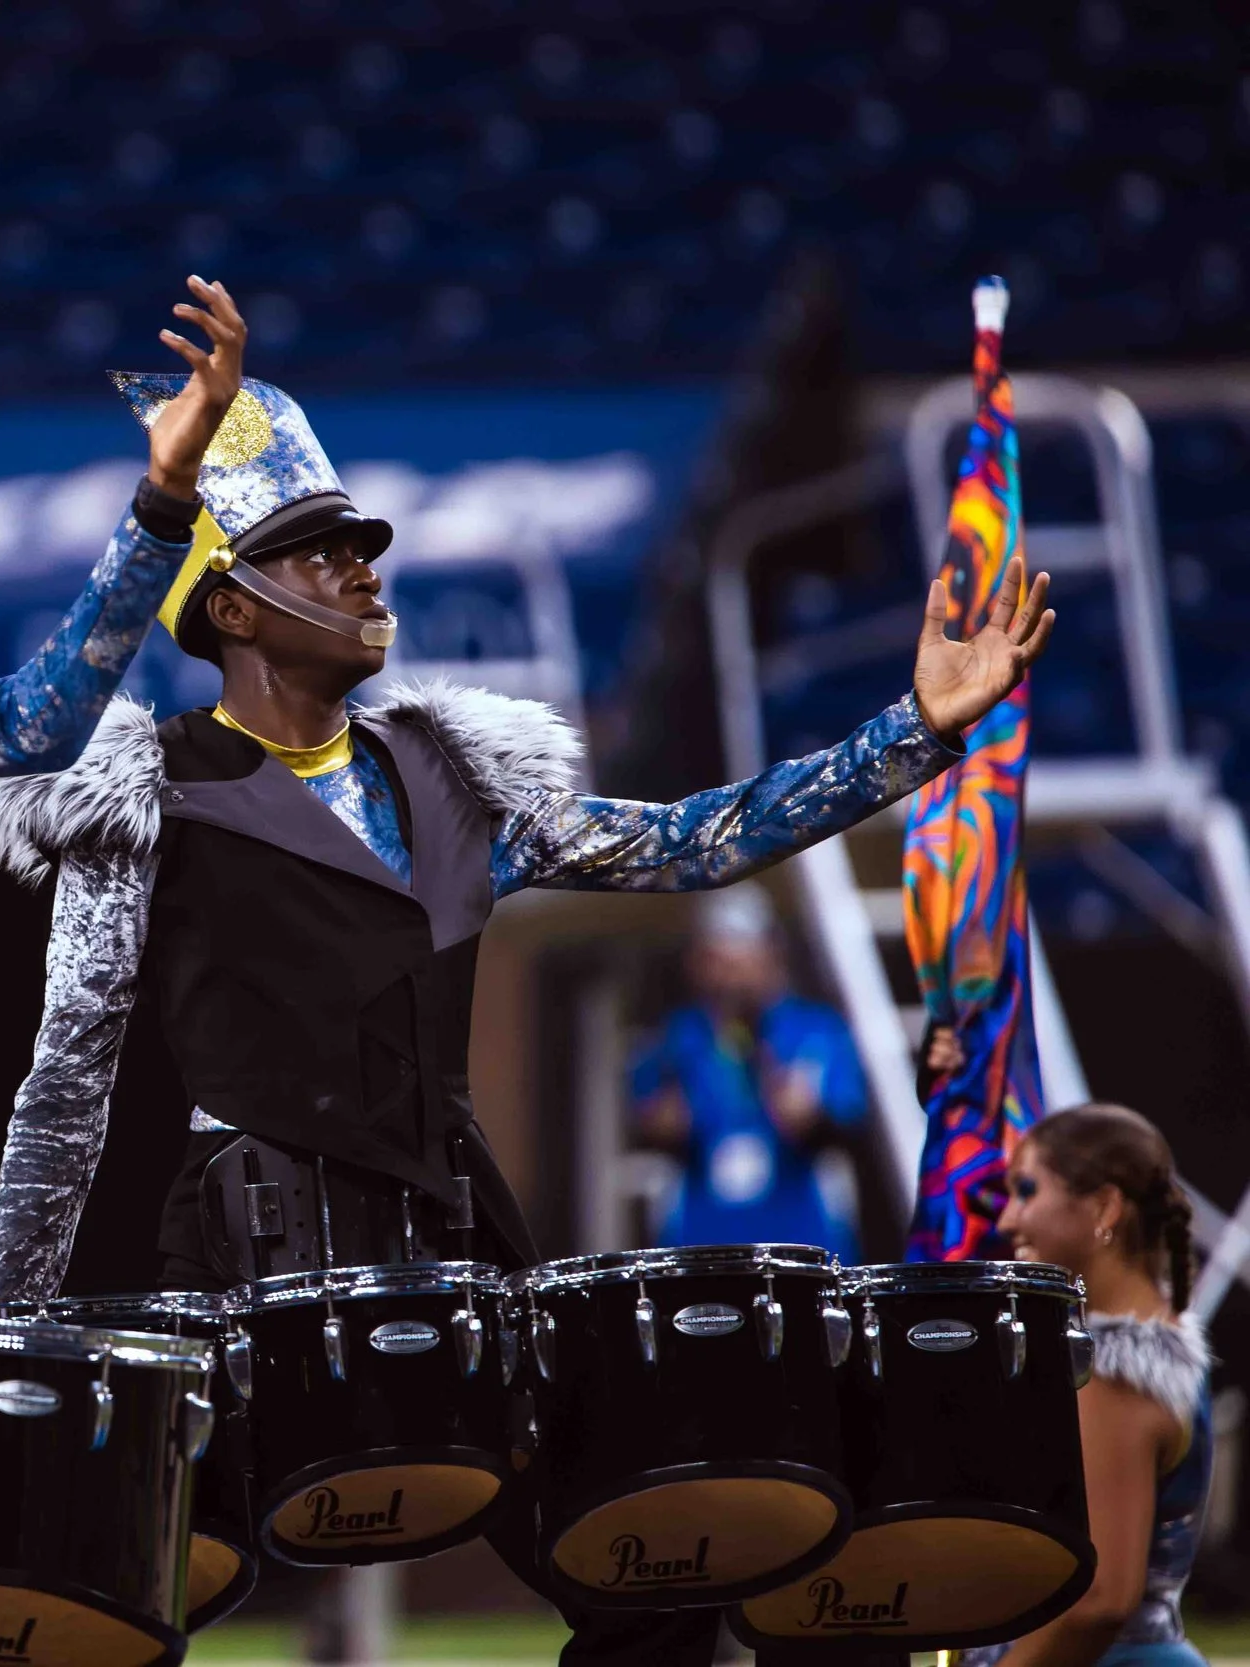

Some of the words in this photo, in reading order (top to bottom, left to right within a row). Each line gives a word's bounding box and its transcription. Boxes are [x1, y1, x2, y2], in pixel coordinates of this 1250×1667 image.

[680, 1315, 739, 1324] CHAMPIONSHIP
[376, 1332, 434, 1342] CHAMPIONSHIP
[913, 1331, 972, 1340] CHAMPIONSHIP
[296, 1486, 404, 1539] Pearl
[600, 1534, 710, 1587] Pearl
[797, 1576, 909, 1629] Pearl
